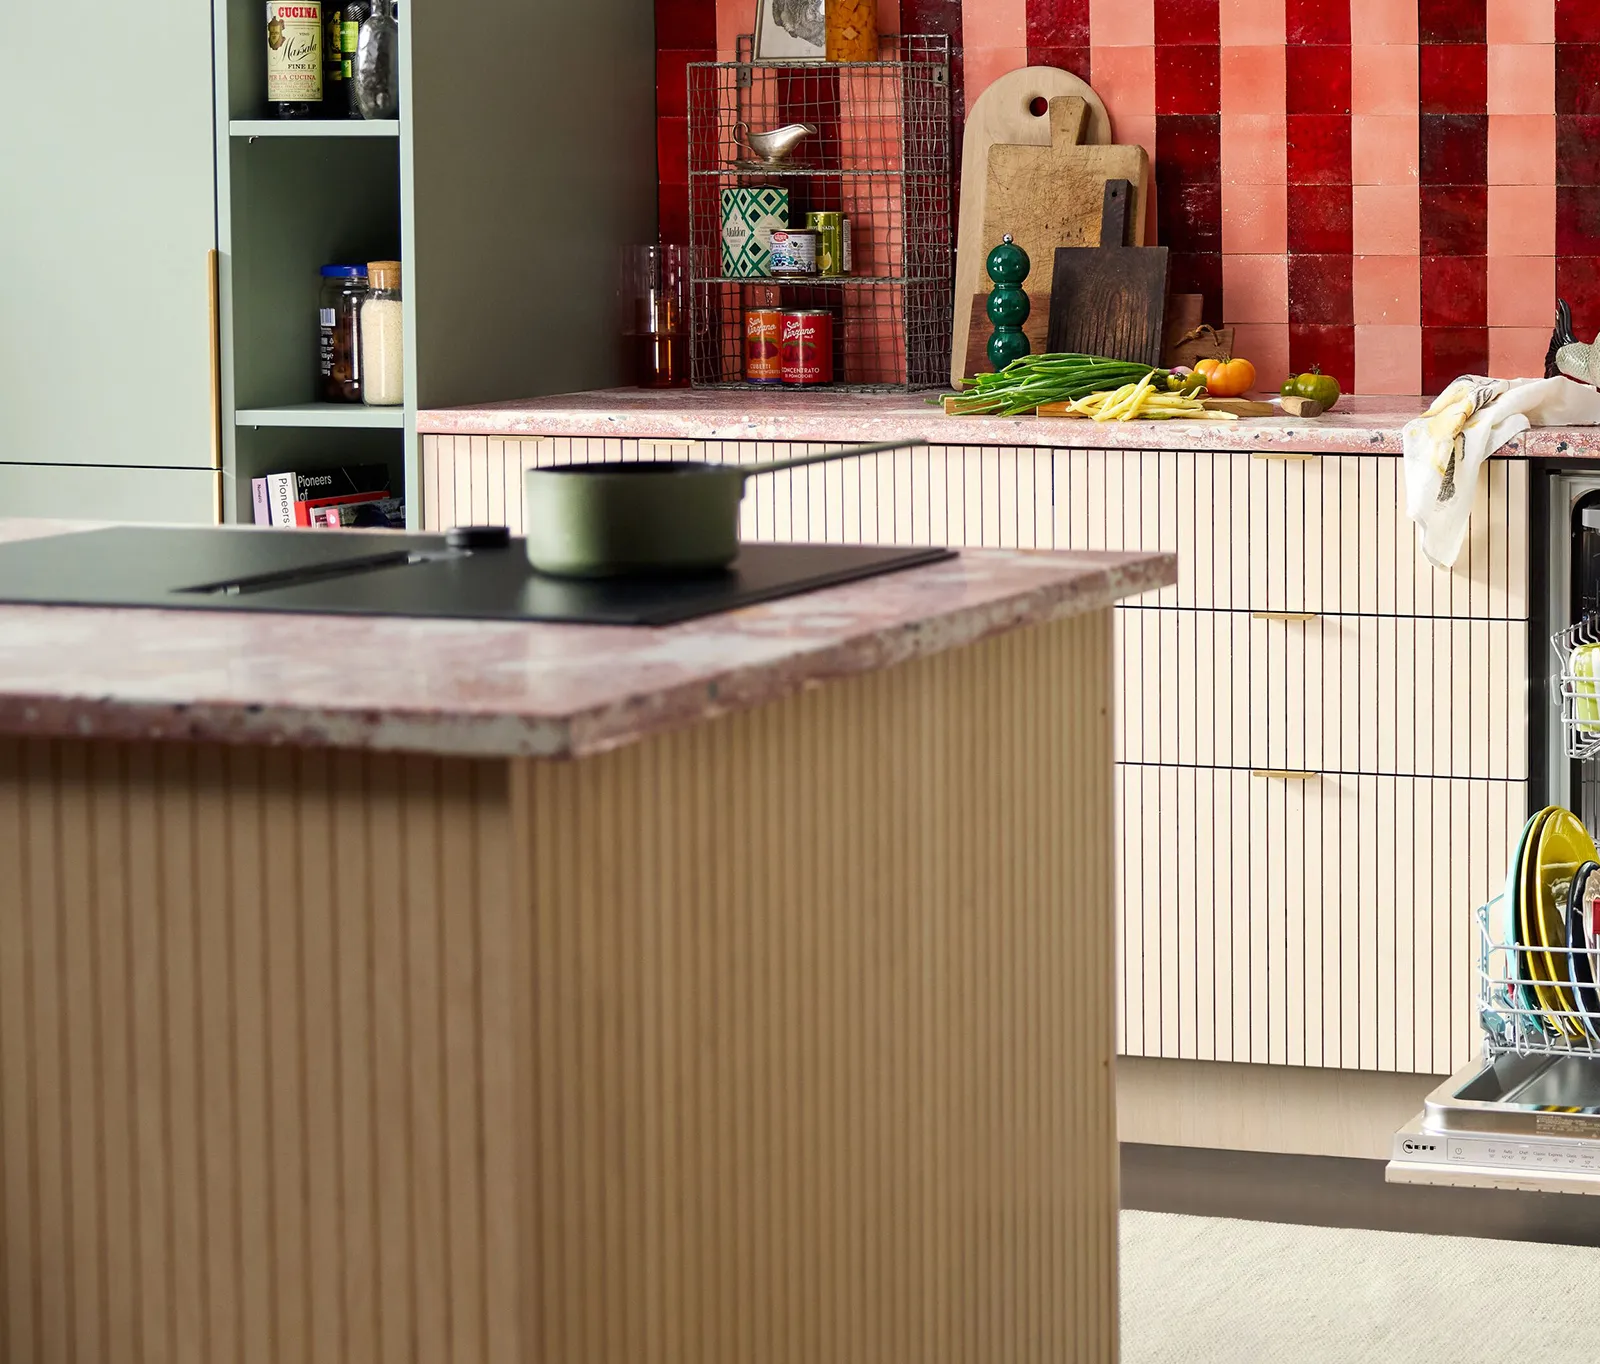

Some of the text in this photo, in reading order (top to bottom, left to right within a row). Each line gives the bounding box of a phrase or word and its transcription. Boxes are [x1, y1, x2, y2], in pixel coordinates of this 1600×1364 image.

[278, 7, 317, 18] CUCINA
[726, 227, 746, 237] Maldon
[749, 317, 761, 327] San
[786, 321, 800, 331] San
[298, 475, 332, 488] Pioneers
[278, 477, 291, 524] Pioneers
[300, 489, 309, 501] of
